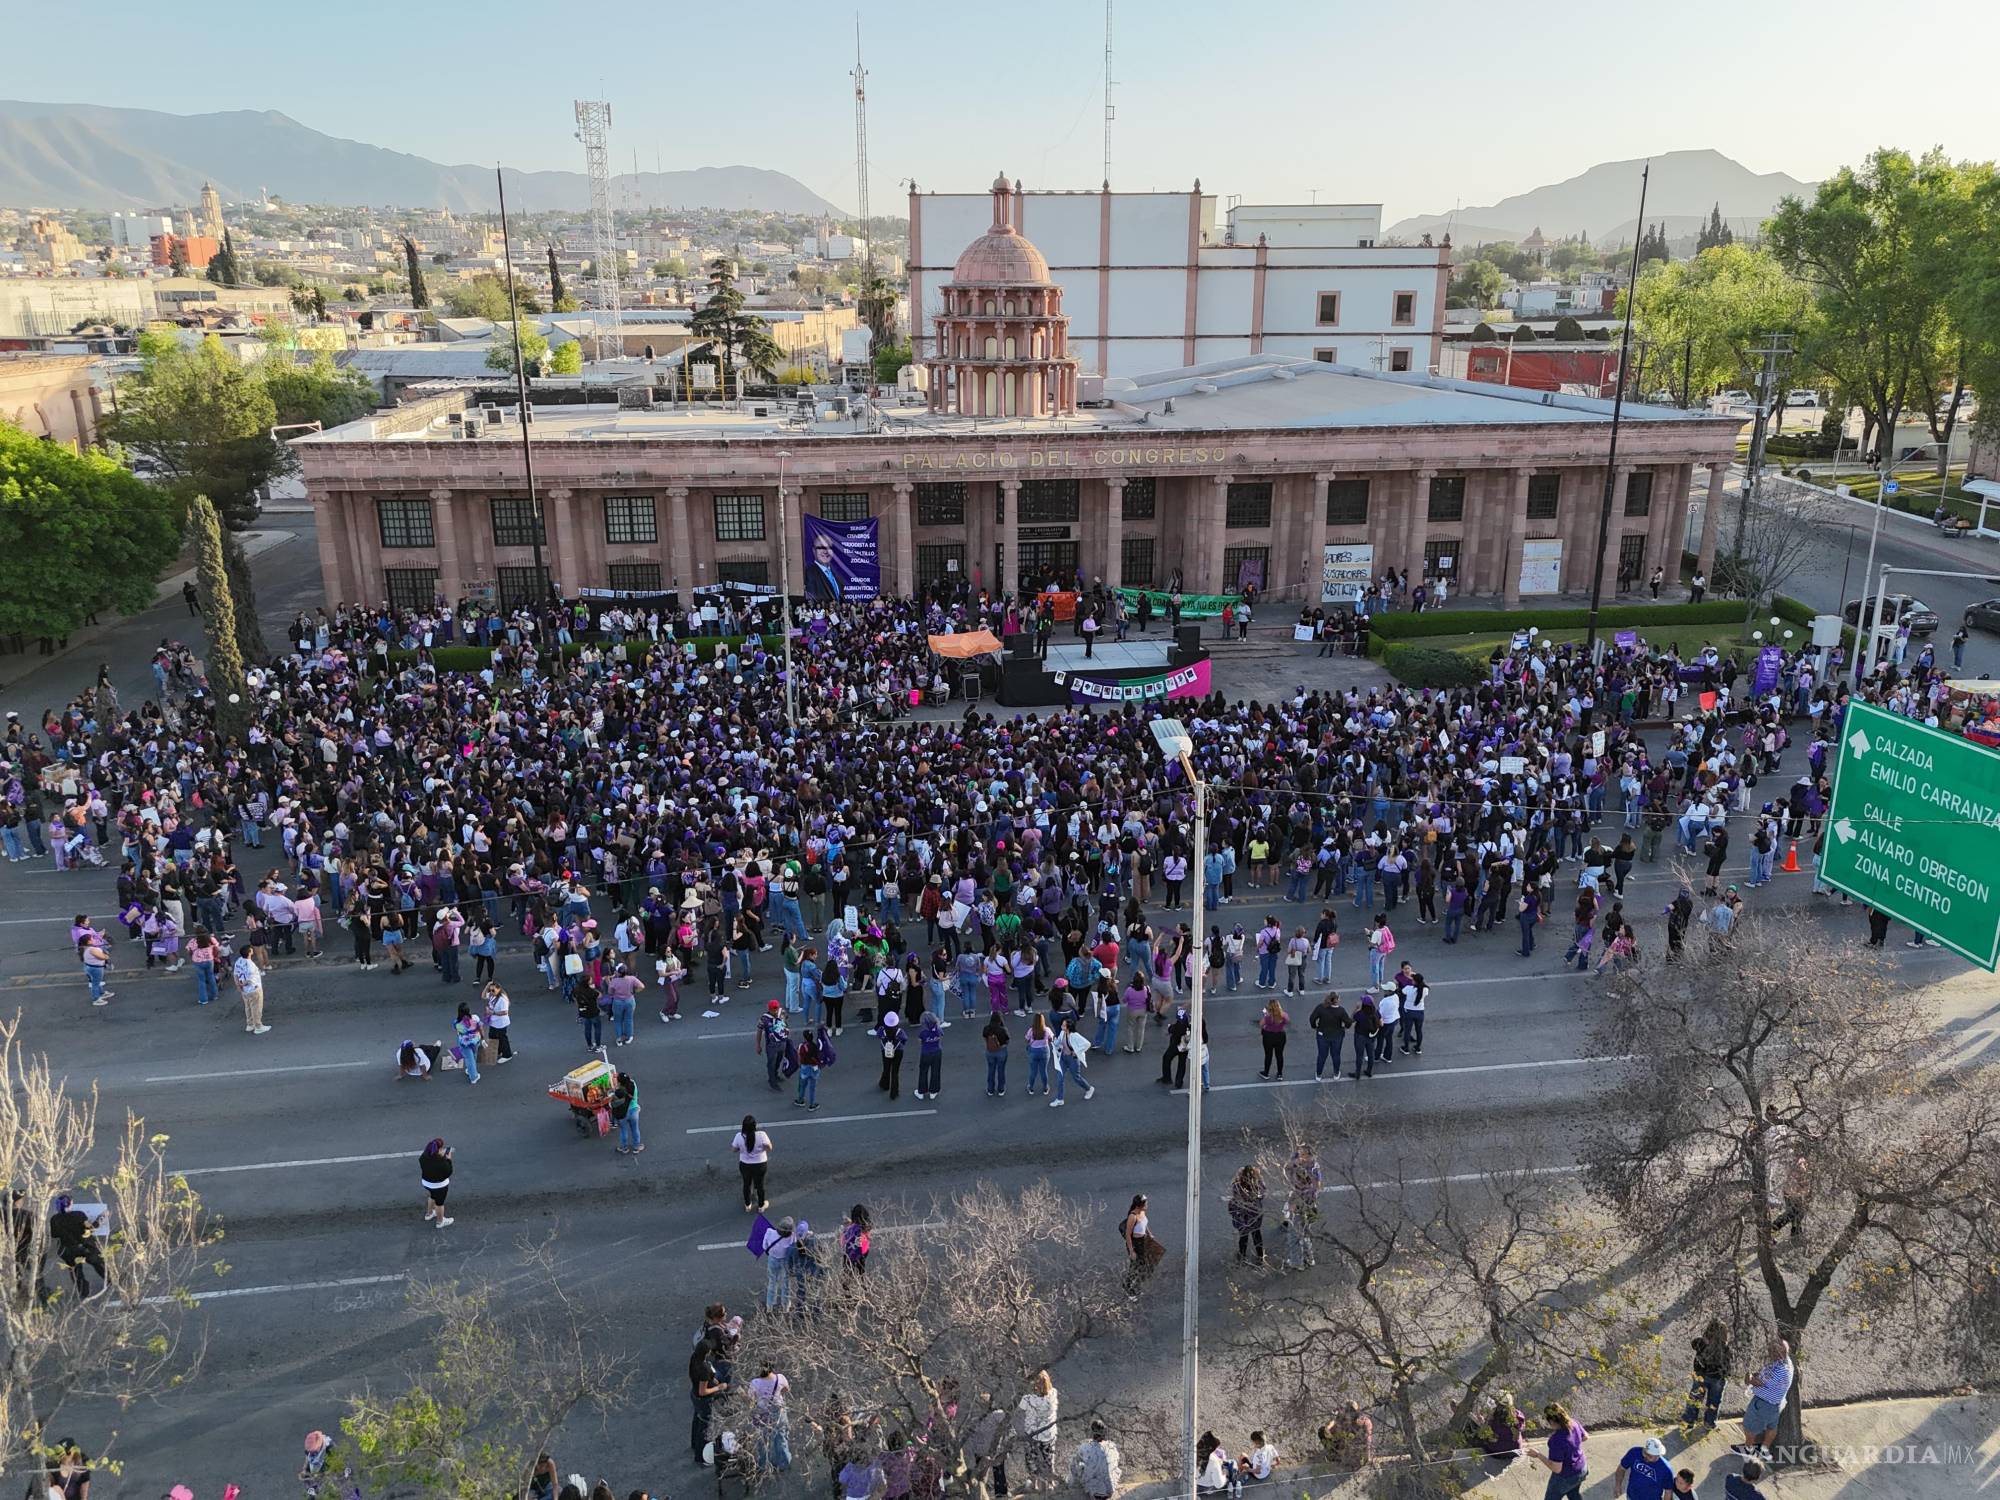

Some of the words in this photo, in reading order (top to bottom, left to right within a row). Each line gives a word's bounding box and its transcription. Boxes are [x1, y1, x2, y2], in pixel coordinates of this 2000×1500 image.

[903, 451, 1014, 469] PALACIO
[1031, 450, 1078, 466] DEL
[1094, 447, 1226, 465] CONGRESO
[1875, 735, 1934, 772] CALZADA
[1863, 803, 1903, 833] CALLE
[1870, 761, 1917, 794] EMILIO
[1920, 782, 2000, 832] CARRANZA
[1854, 853, 1890, 886] ZONA
[1895, 874, 1951, 914] CENTRO
[1859, 829, 1914, 866] ALVARO
[1919, 856, 1989, 904] OBREGON
